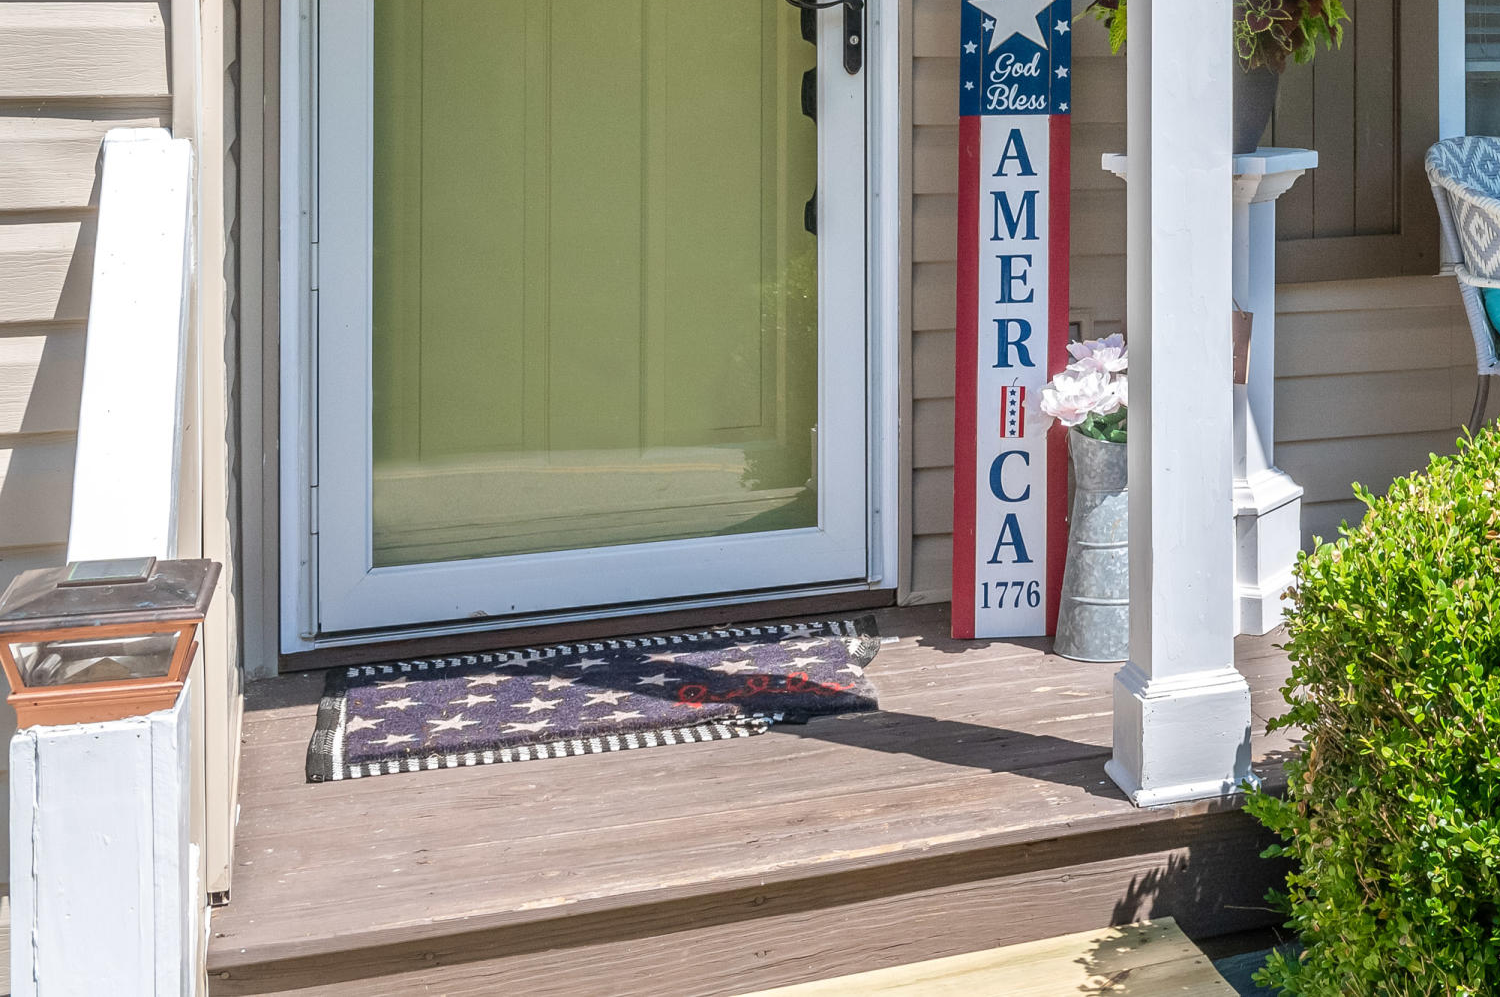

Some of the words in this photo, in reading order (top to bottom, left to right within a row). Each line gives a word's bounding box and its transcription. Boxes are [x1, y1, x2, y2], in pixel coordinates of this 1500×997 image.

[990, 52, 1041, 83] God
[986, 83, 1047, 110] Bless
[980, 580, 1041, 609] 1776
